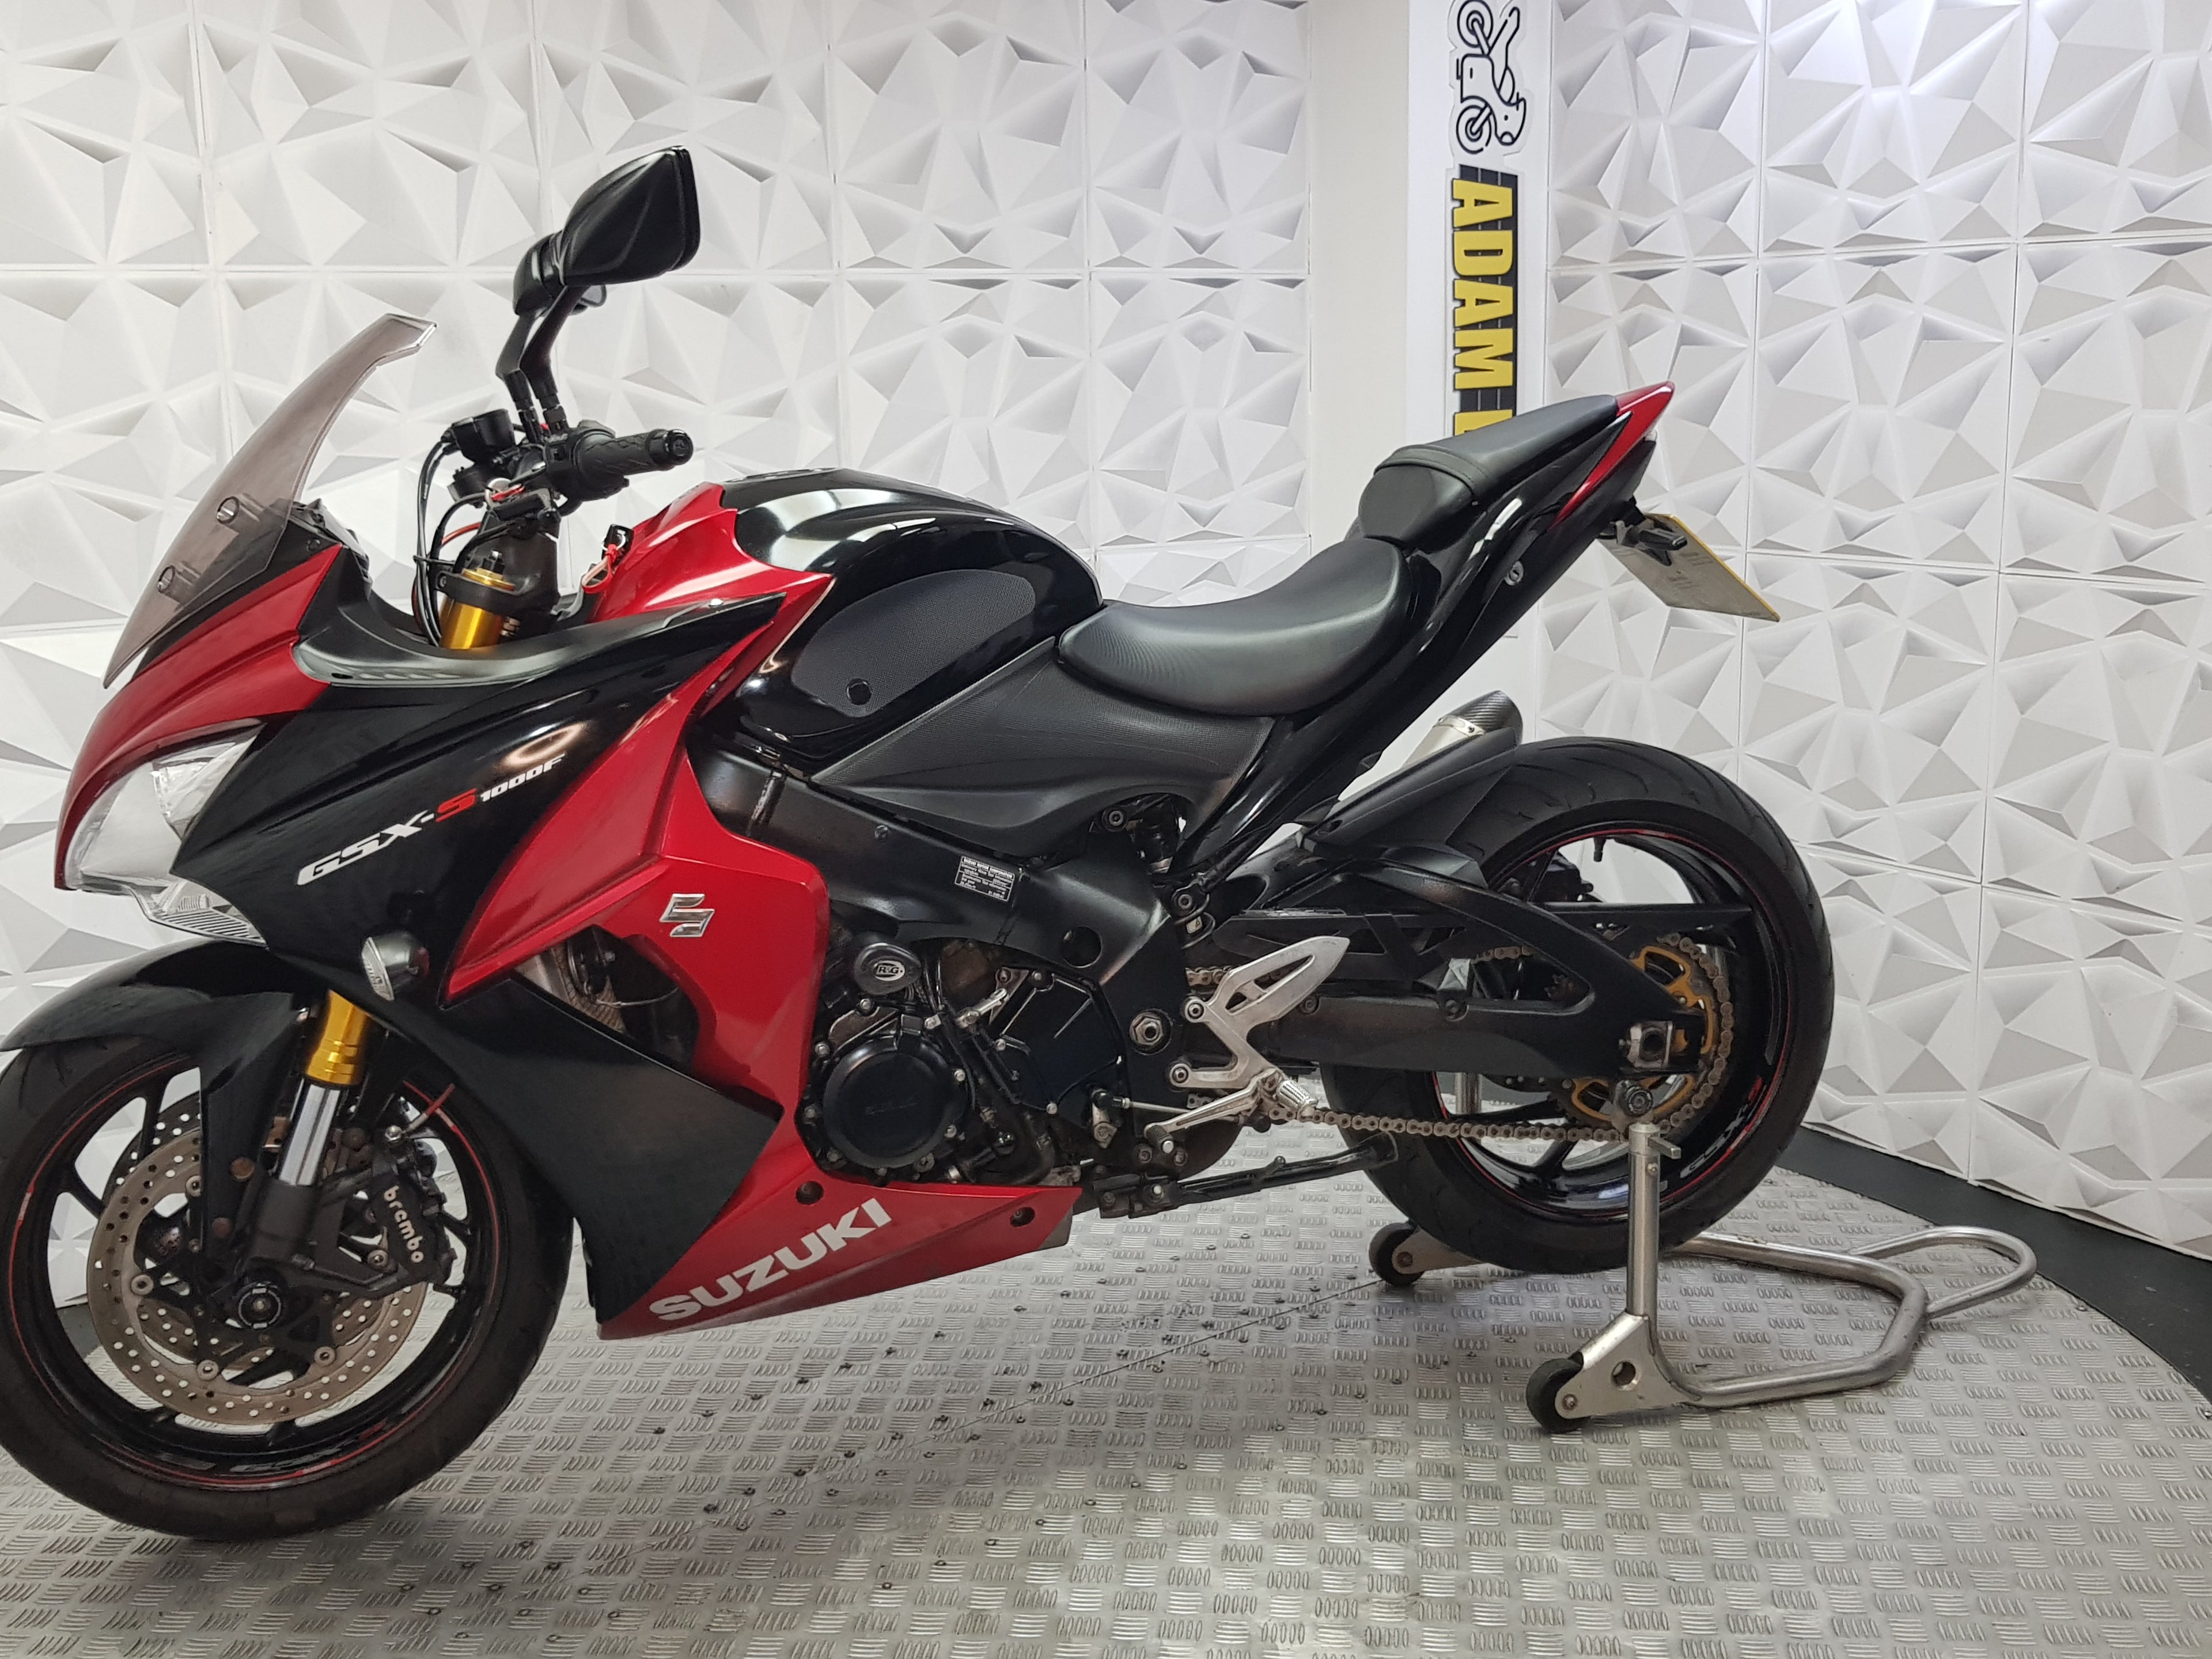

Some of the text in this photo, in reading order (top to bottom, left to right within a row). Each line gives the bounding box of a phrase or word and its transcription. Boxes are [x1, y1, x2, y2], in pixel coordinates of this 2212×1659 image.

[1452, 179, 1513, 391] ADAM
[384, 1185, 424, 1263] brembo
[649, 1197, 892, 1321] SUZUKI
